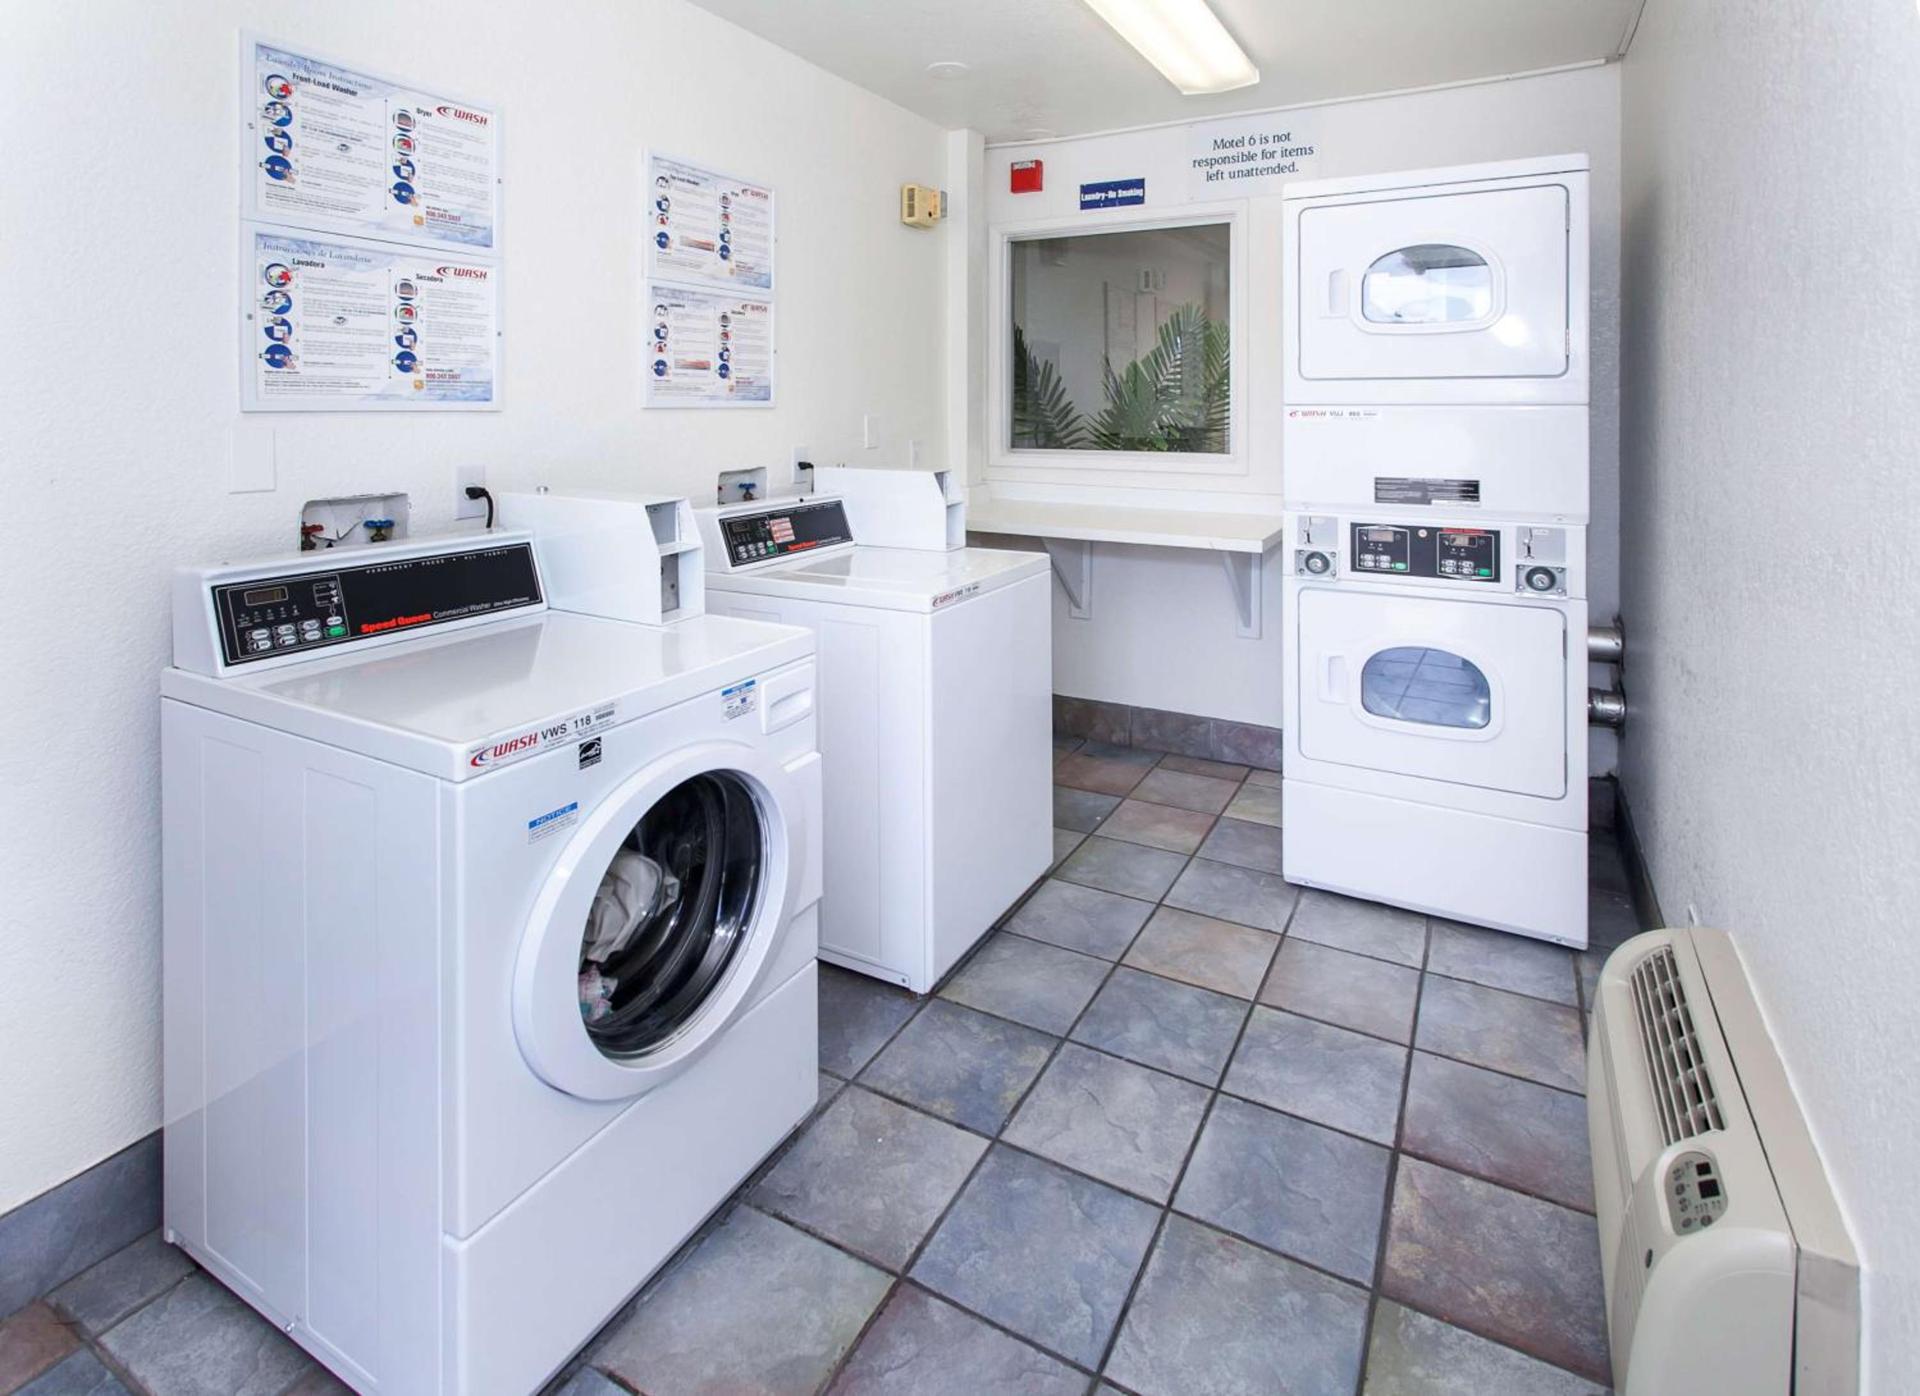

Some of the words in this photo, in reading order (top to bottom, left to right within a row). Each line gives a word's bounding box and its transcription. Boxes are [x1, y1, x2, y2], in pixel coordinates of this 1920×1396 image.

[292, 72, 330, 90] Front-Load
[332, 84, 358, 97] Washer
[453, 109, 488, 125] WASH
[1213, 136, 1245, 151] Motel
[1248, 136, 1256, 147] 6
[1259, 133, 1269, 145] is
[1272, 132, 1291, 144] not
[1192, 151, 1258, 169] responsible
[1261, 149, 1277, 161] for
[1280, 146, 1314, 159] items
[1206, 170, 1224, 182] left
[1228, 162, 1300, 179] unattended.
[292, 258, 326, 269] Lavadora
[416, 273, 444, 284] Secadora
[453, 267, 488, 281] WASH
[360, 618, 397, 634] Speed
[397, 612, 433, 626] Queen
[470, 601, 492, 613] Washer
[493, 731, 538, 758] WASH
[541, 723, 568, 740] VWS
[574, 715, 592, 729] 118
